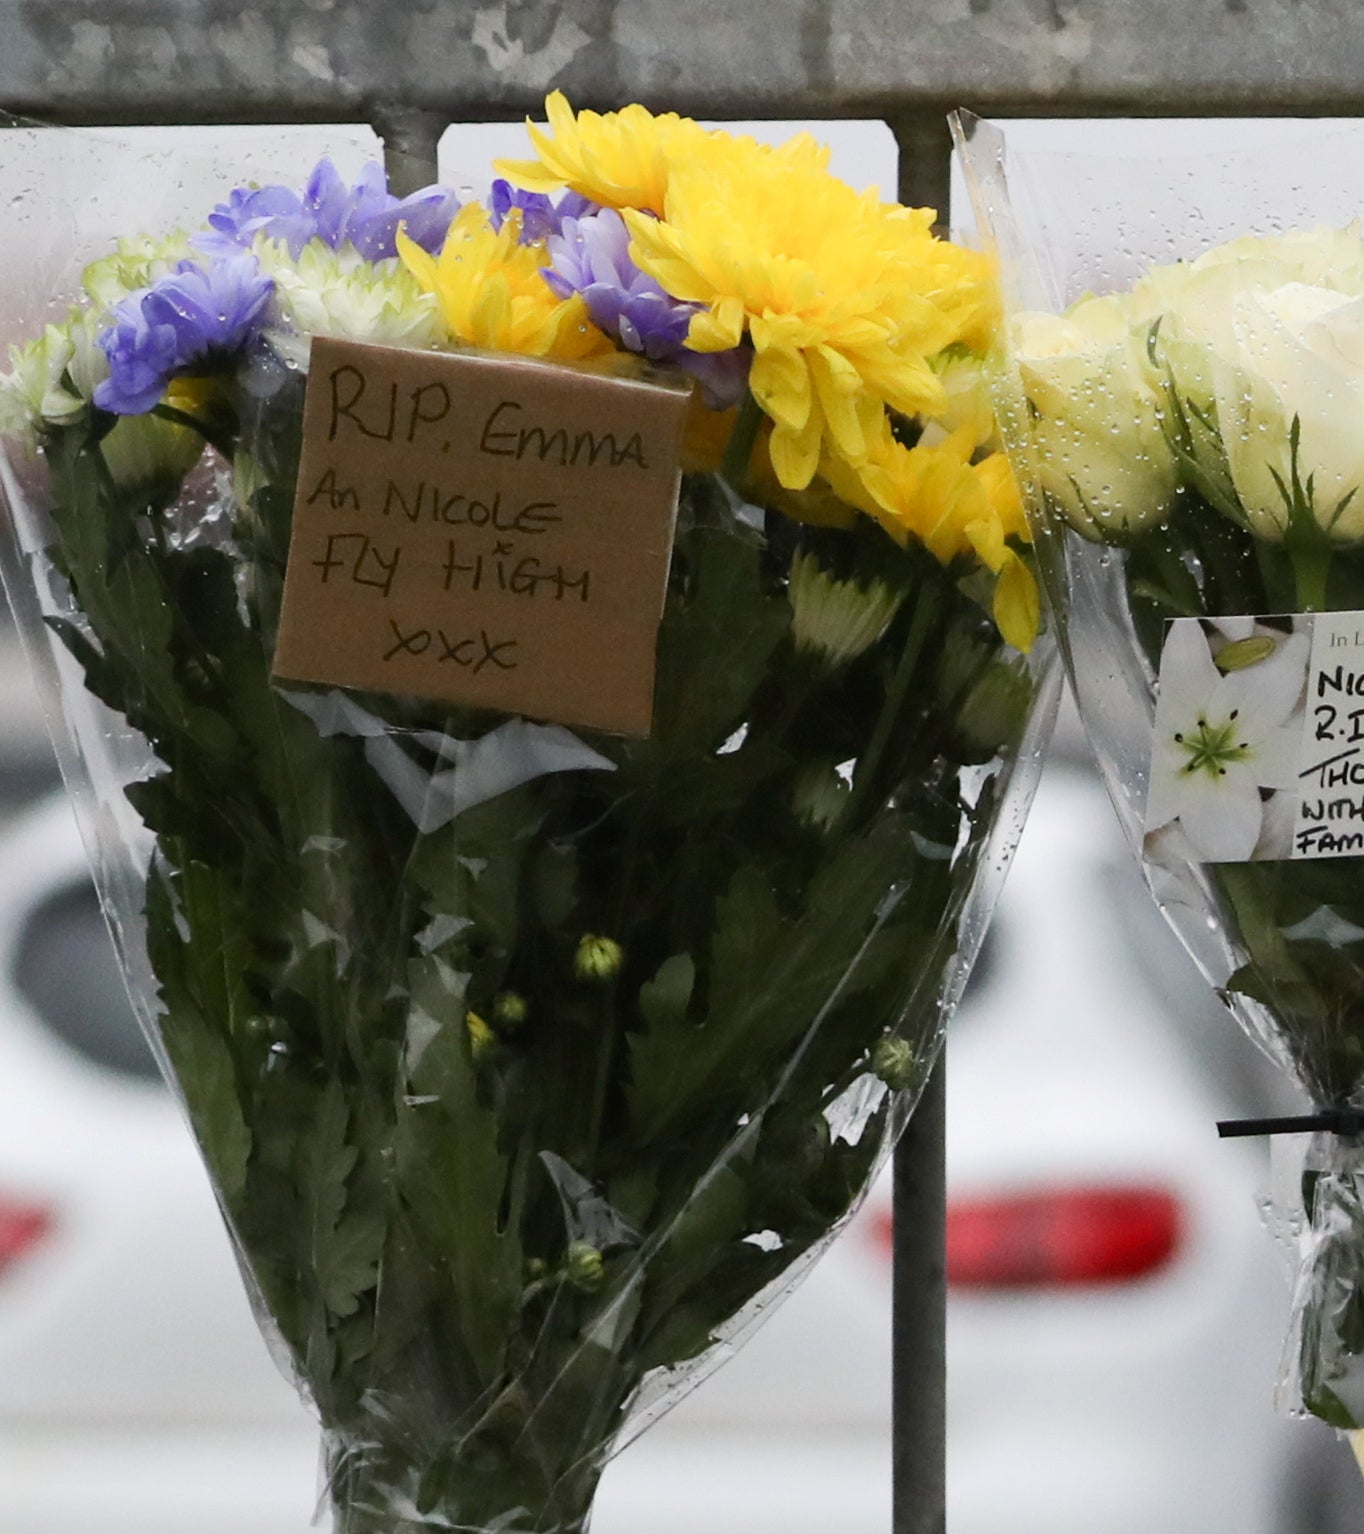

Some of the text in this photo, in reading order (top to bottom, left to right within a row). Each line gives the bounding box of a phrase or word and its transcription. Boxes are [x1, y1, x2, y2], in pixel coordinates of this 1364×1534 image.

[383, 481, 563, 534] NICOLE
[312, 534, 400, 598] FLY
[1329, 632, 1349, 648] In
